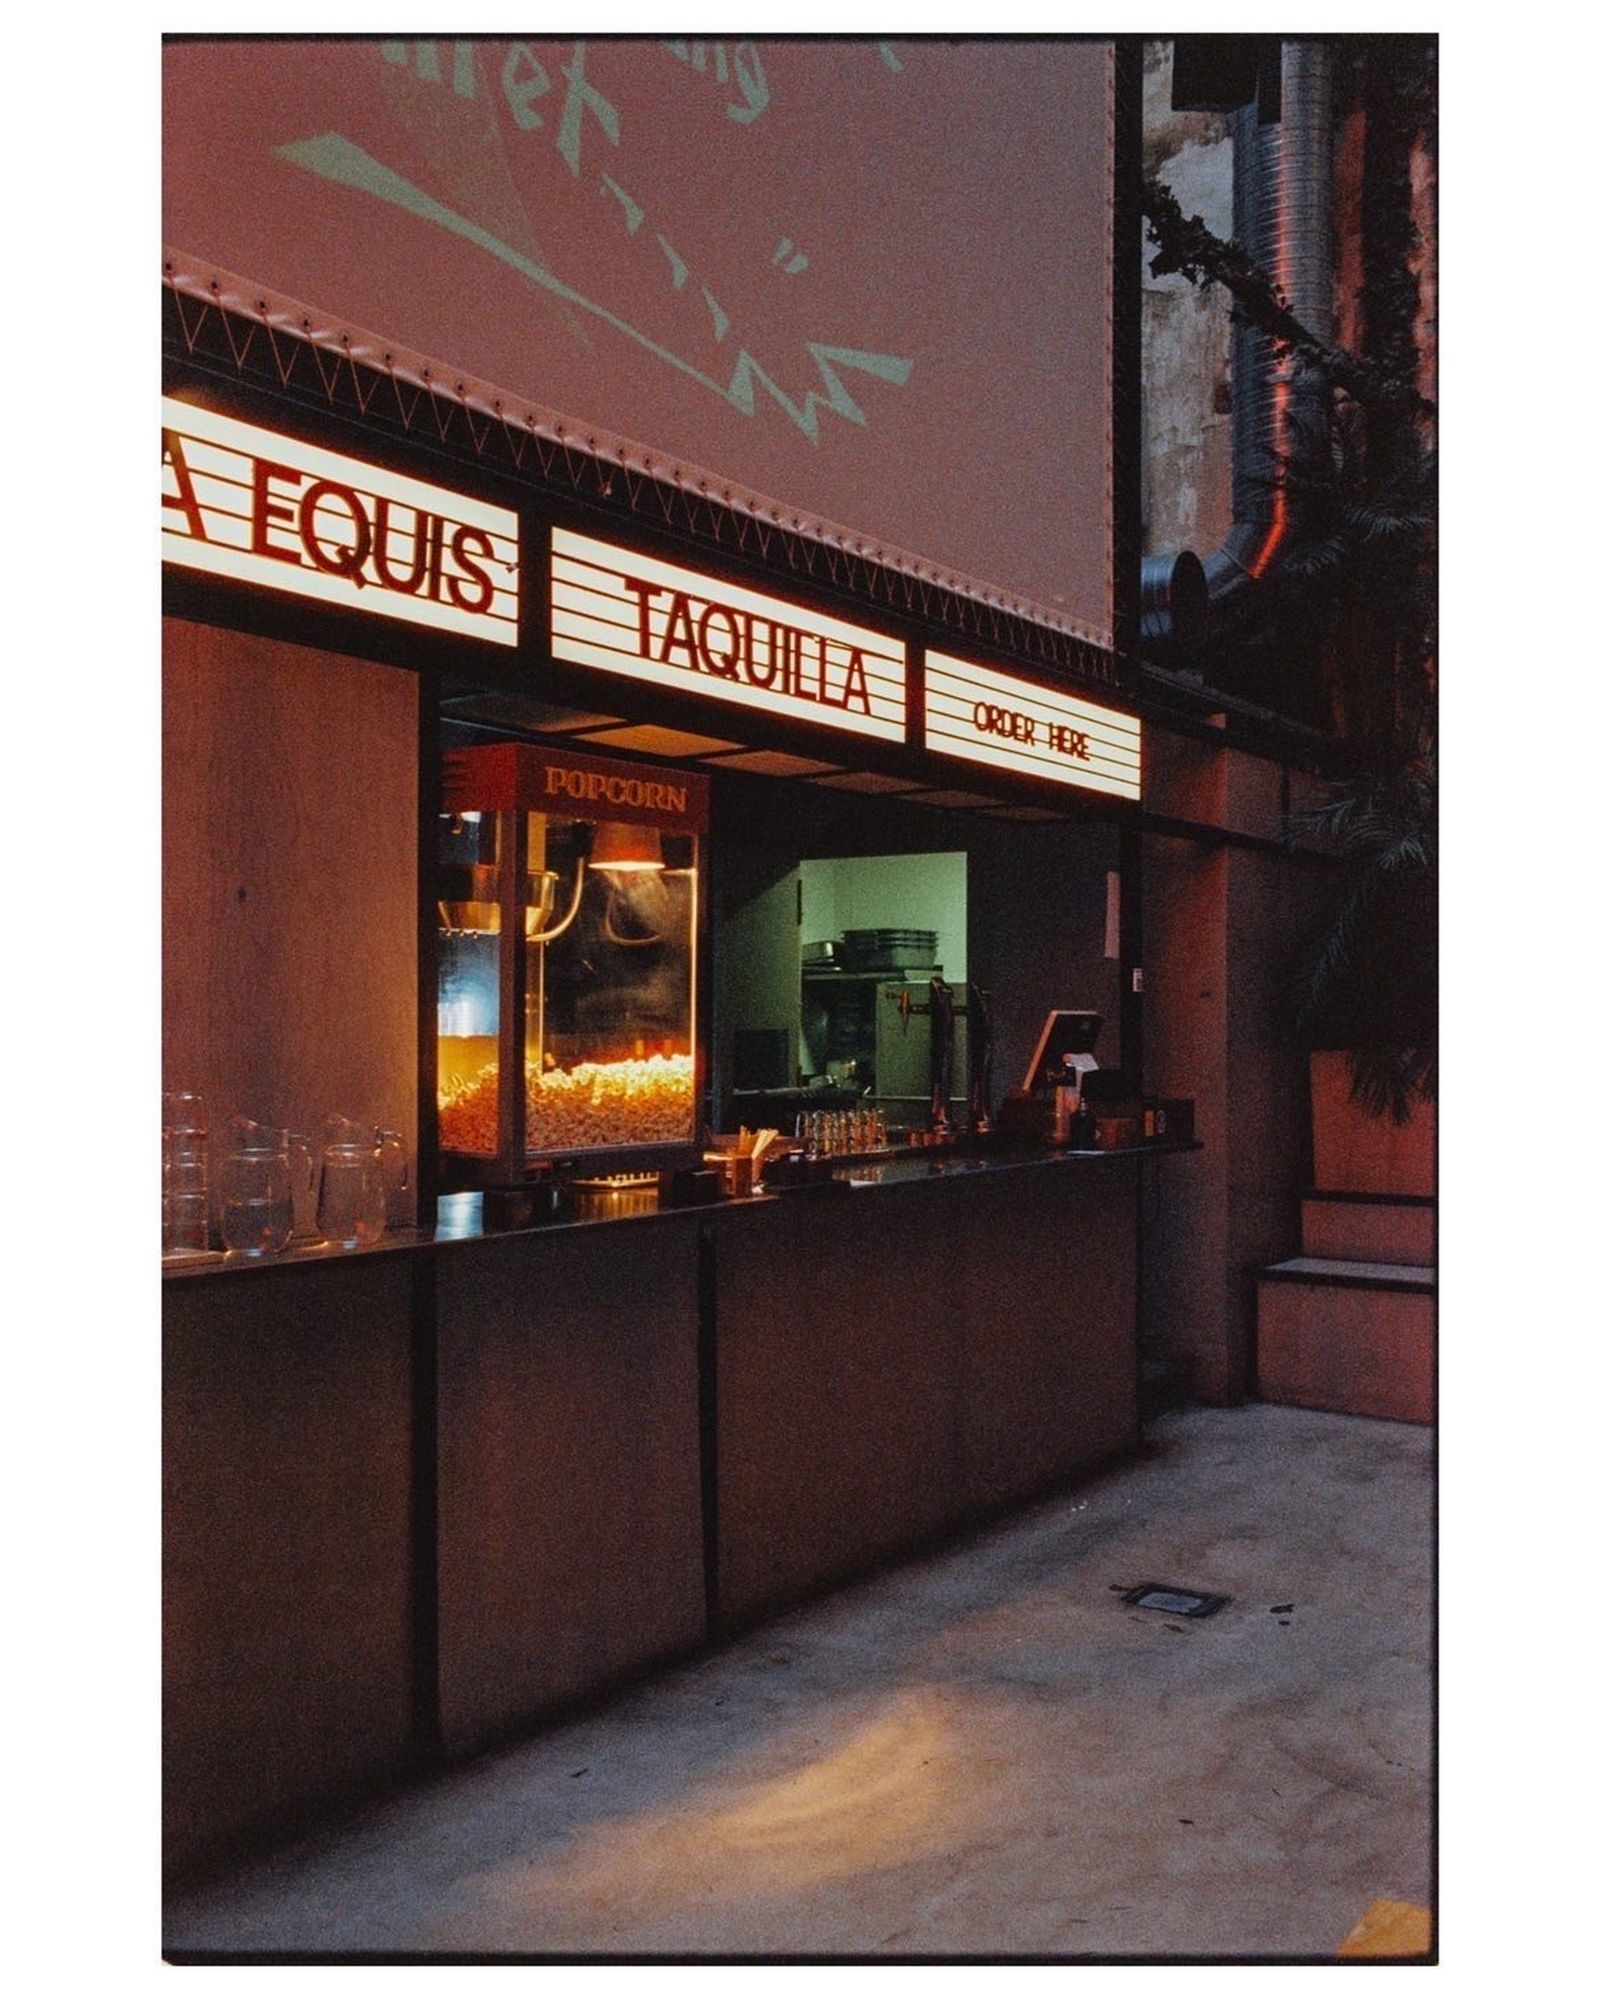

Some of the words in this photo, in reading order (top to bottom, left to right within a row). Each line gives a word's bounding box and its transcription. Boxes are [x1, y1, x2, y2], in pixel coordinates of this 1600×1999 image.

[252, 456, 496, 614] EQUIS
[624, 576, 873, 716] TAQUILLA
[972, 701, 1036, 748] ORDER
[1048, 724, 1092, 762] HERE
[544, 766, 688, 814] POPCORN
